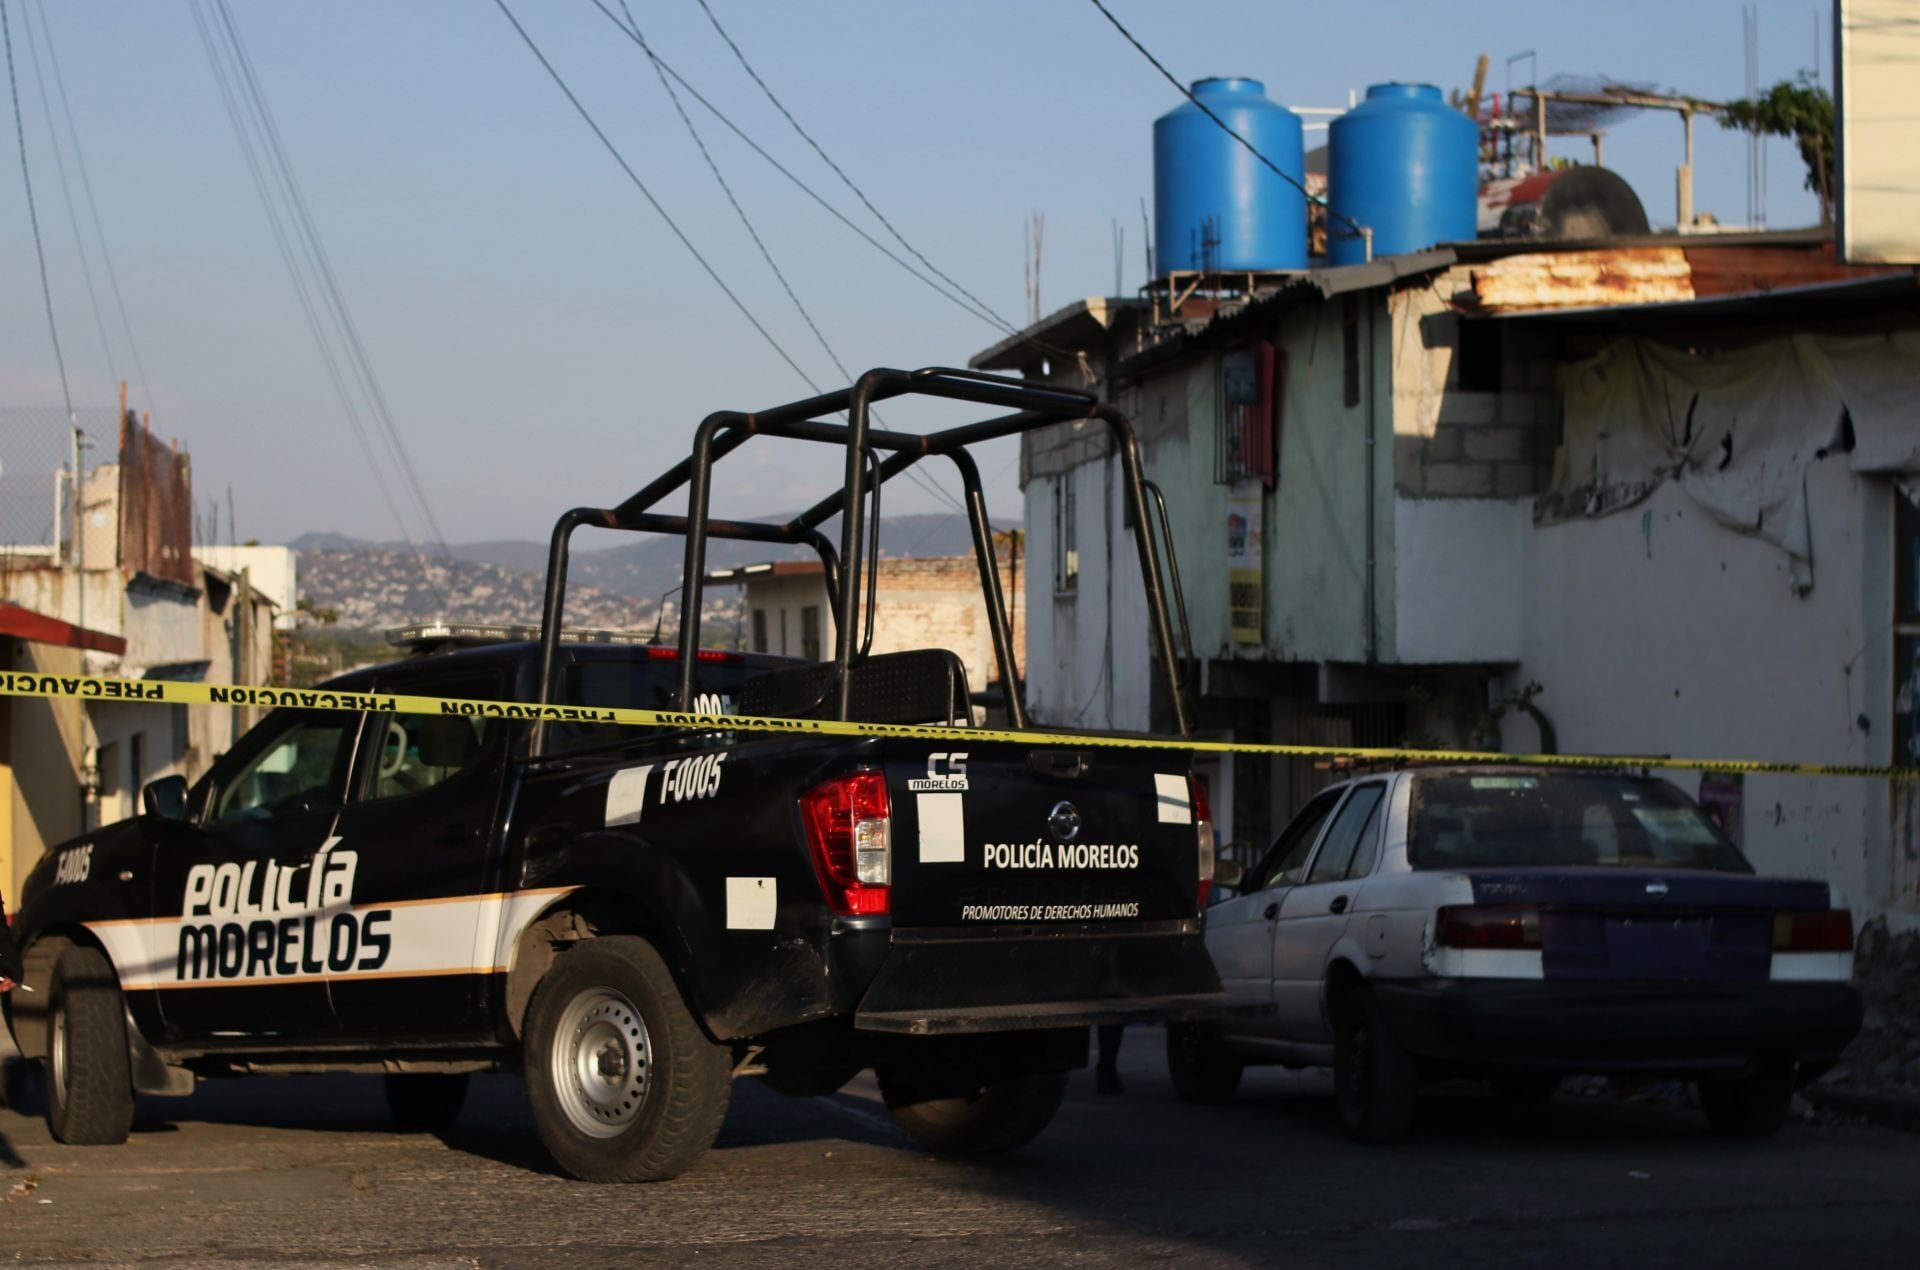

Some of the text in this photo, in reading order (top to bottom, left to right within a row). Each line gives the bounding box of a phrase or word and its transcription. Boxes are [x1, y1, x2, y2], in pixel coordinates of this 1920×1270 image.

[0, 674, 164, 699] PRECAUCI
[210, 687, 396, 711] PRECAUCION
[660, 752, 728, 804] T-0005
[927, 753, 968, 779] CS
[912, 780, 965, 789] MORELOS
[984, 838, 1139, 869] POLICÍA MORELOS
[962, 902, 1139, 920] PROMOTORES DE DERECHOS HUMANOS
[177, 909, 392, 981] MORELOS
